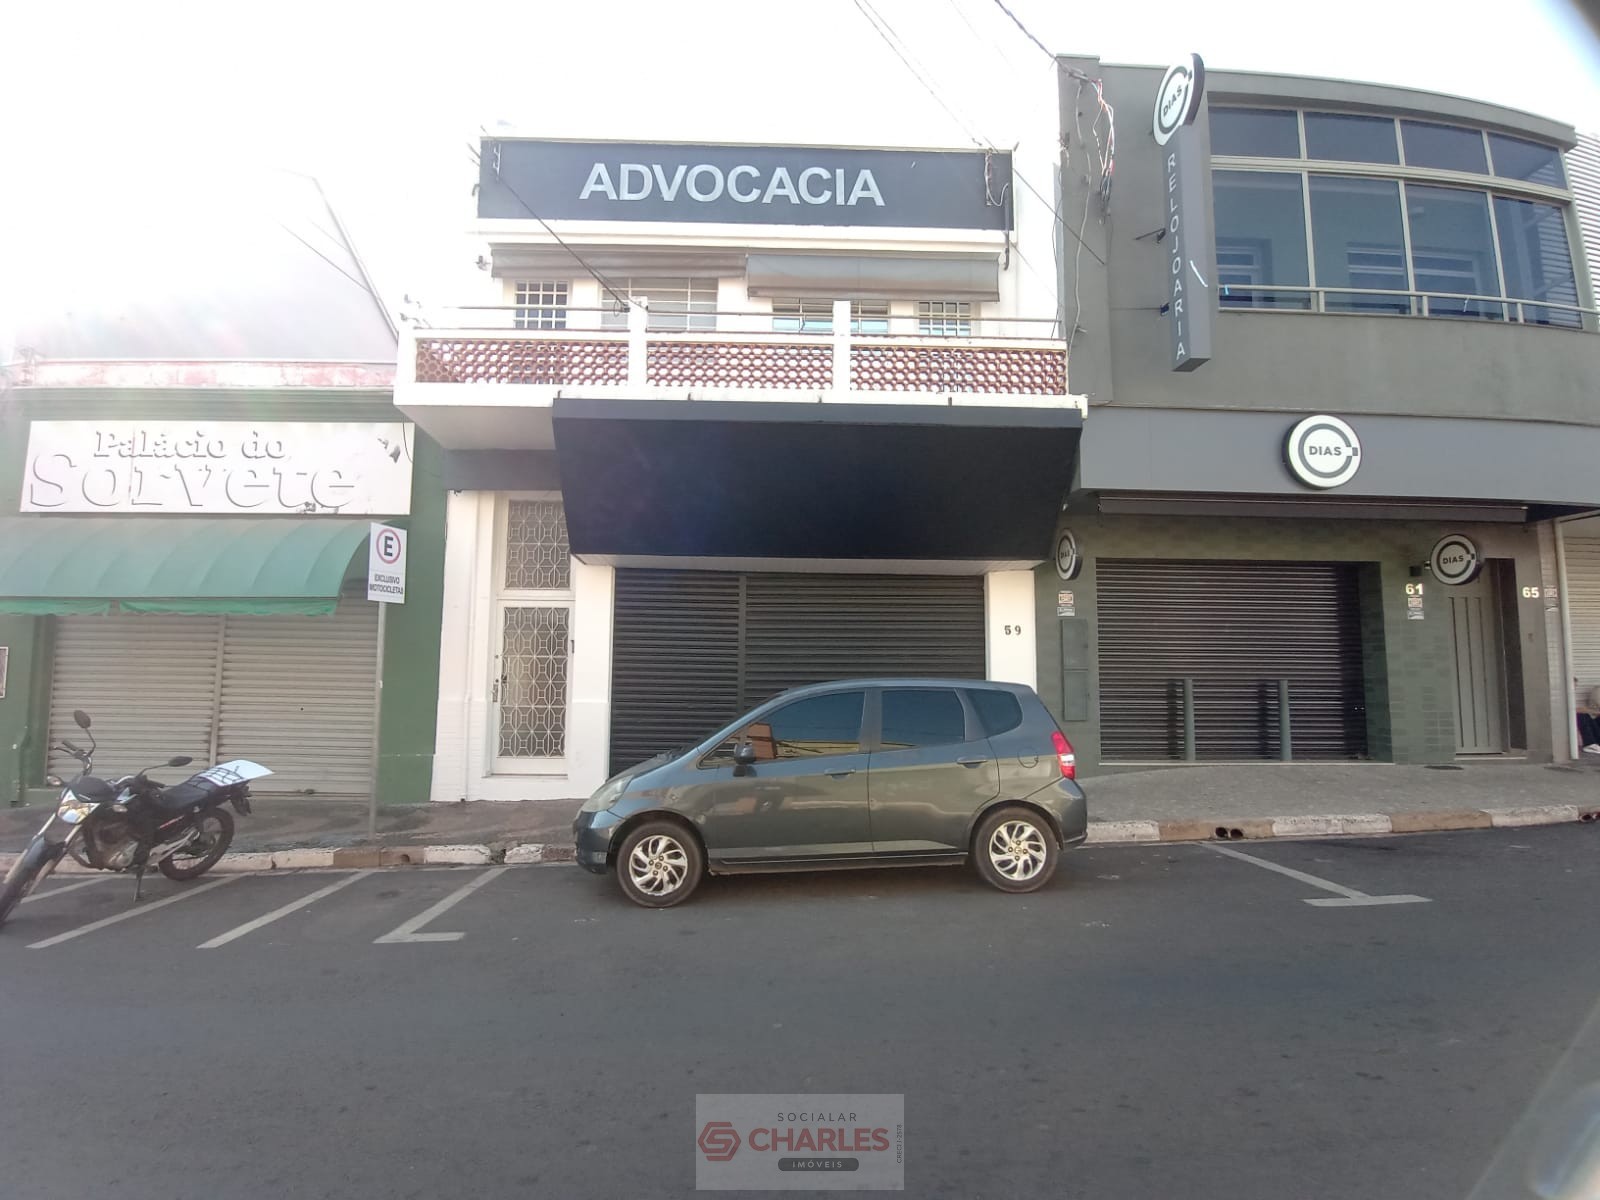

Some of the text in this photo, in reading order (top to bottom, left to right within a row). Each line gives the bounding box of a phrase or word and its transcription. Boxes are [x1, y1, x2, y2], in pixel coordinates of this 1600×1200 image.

[1162, 84, 1182, 118] DIAS
[578, 162, 886, 207] ADVOCACIA
[1166, 152, 1186, 361] RELOJOARIA
[241, 428, 289, 460] do
[1308, 445, 1342, 456] DIAS
[29, 453, 360, 508] Sorvete
[383, 535, 394, 557] E
[1442, 554, 1464, 565] DIAS
[374, 573, 401, 585] EXCLUSIVO
[1405, 583, 1424, 595] 61
[1522, 586, 1540, 598] 65
[1004, 624, 1022, 636] 59
